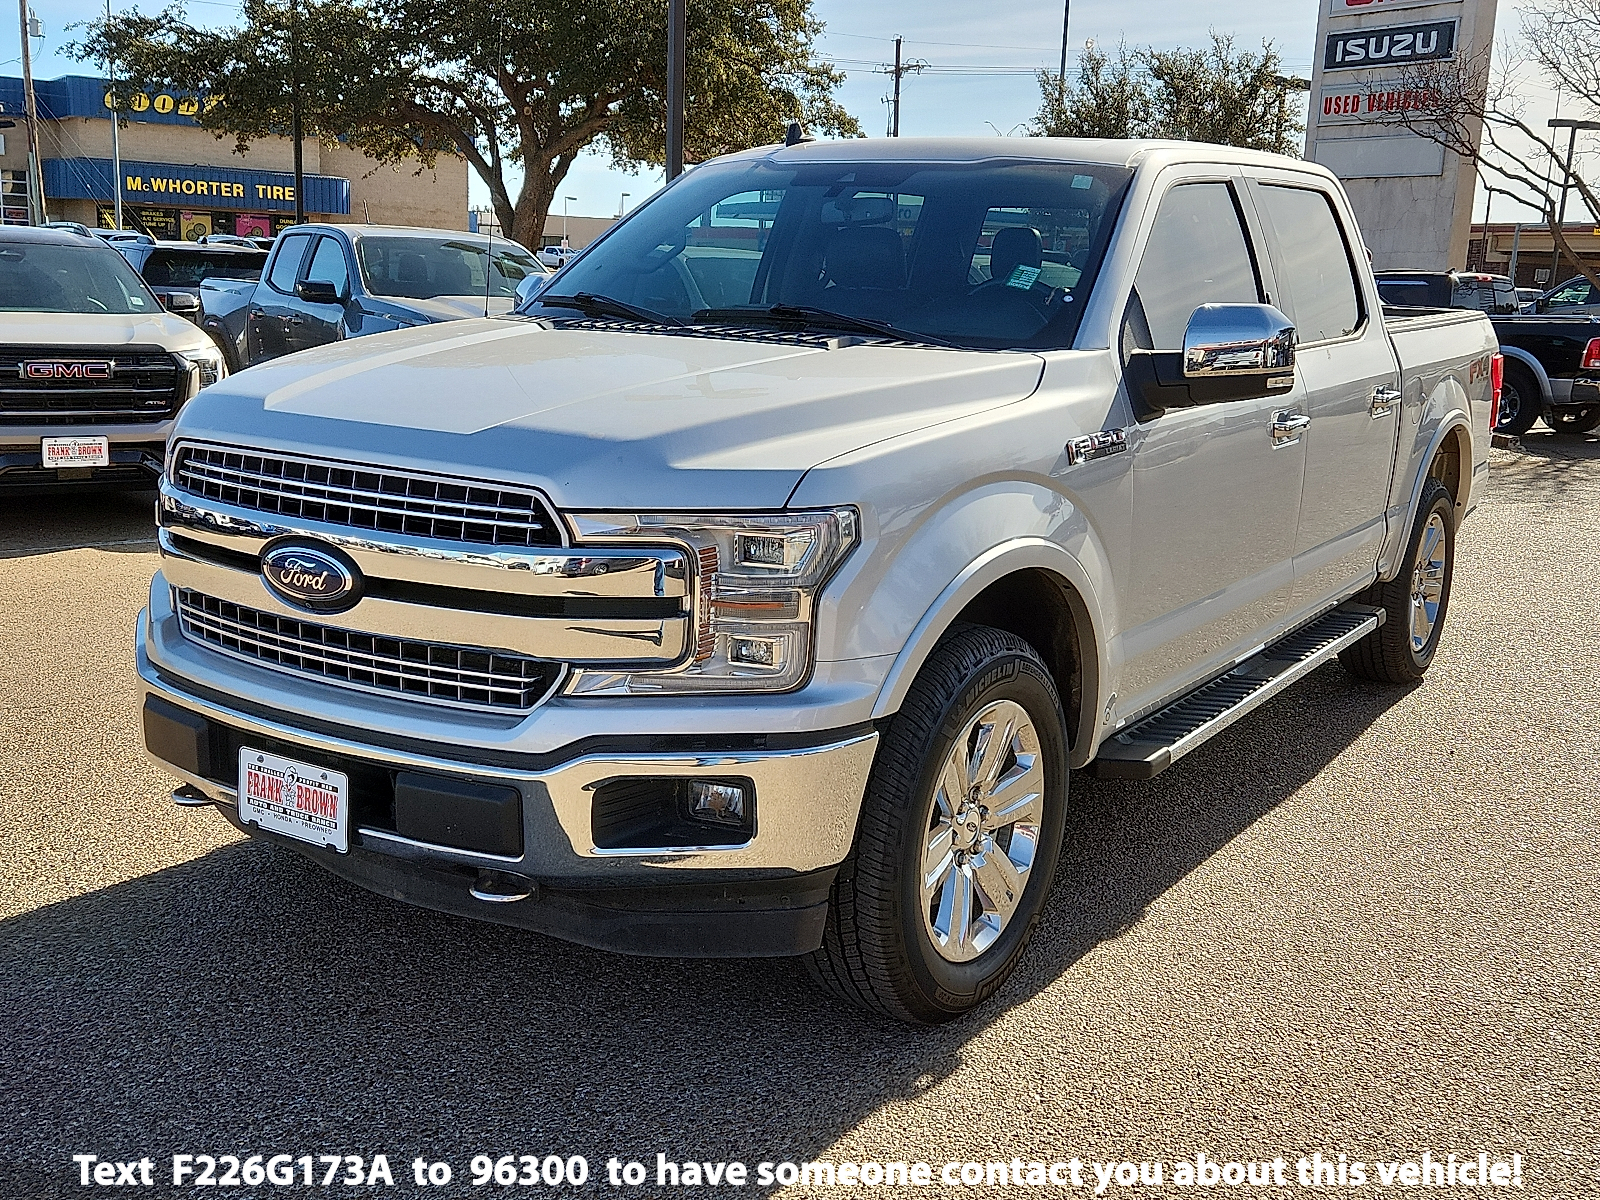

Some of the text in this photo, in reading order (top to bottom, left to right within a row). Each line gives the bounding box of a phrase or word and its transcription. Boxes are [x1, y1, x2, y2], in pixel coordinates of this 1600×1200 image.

[1335, 31, 1438, 62] ISUZU
[1323, 95, 1360, 115] USED
[255, 184, 295, 201] TIRE
[27, 363, 108, 378] GMC
[1470, 355, 1489, 384] FX4
[47, 445, 103, 456] FRANK BROWN
[280, 558, 328, 590] Ford
[965, 662, 1014, 708] MICHELIN
[247, 770, 338, 820] FRANK BROWN
[249, 798, 336, 829] AUTO AND TRUCK RANCH
[252, 806, 333, 836] GMC HONDA PREOWNED
